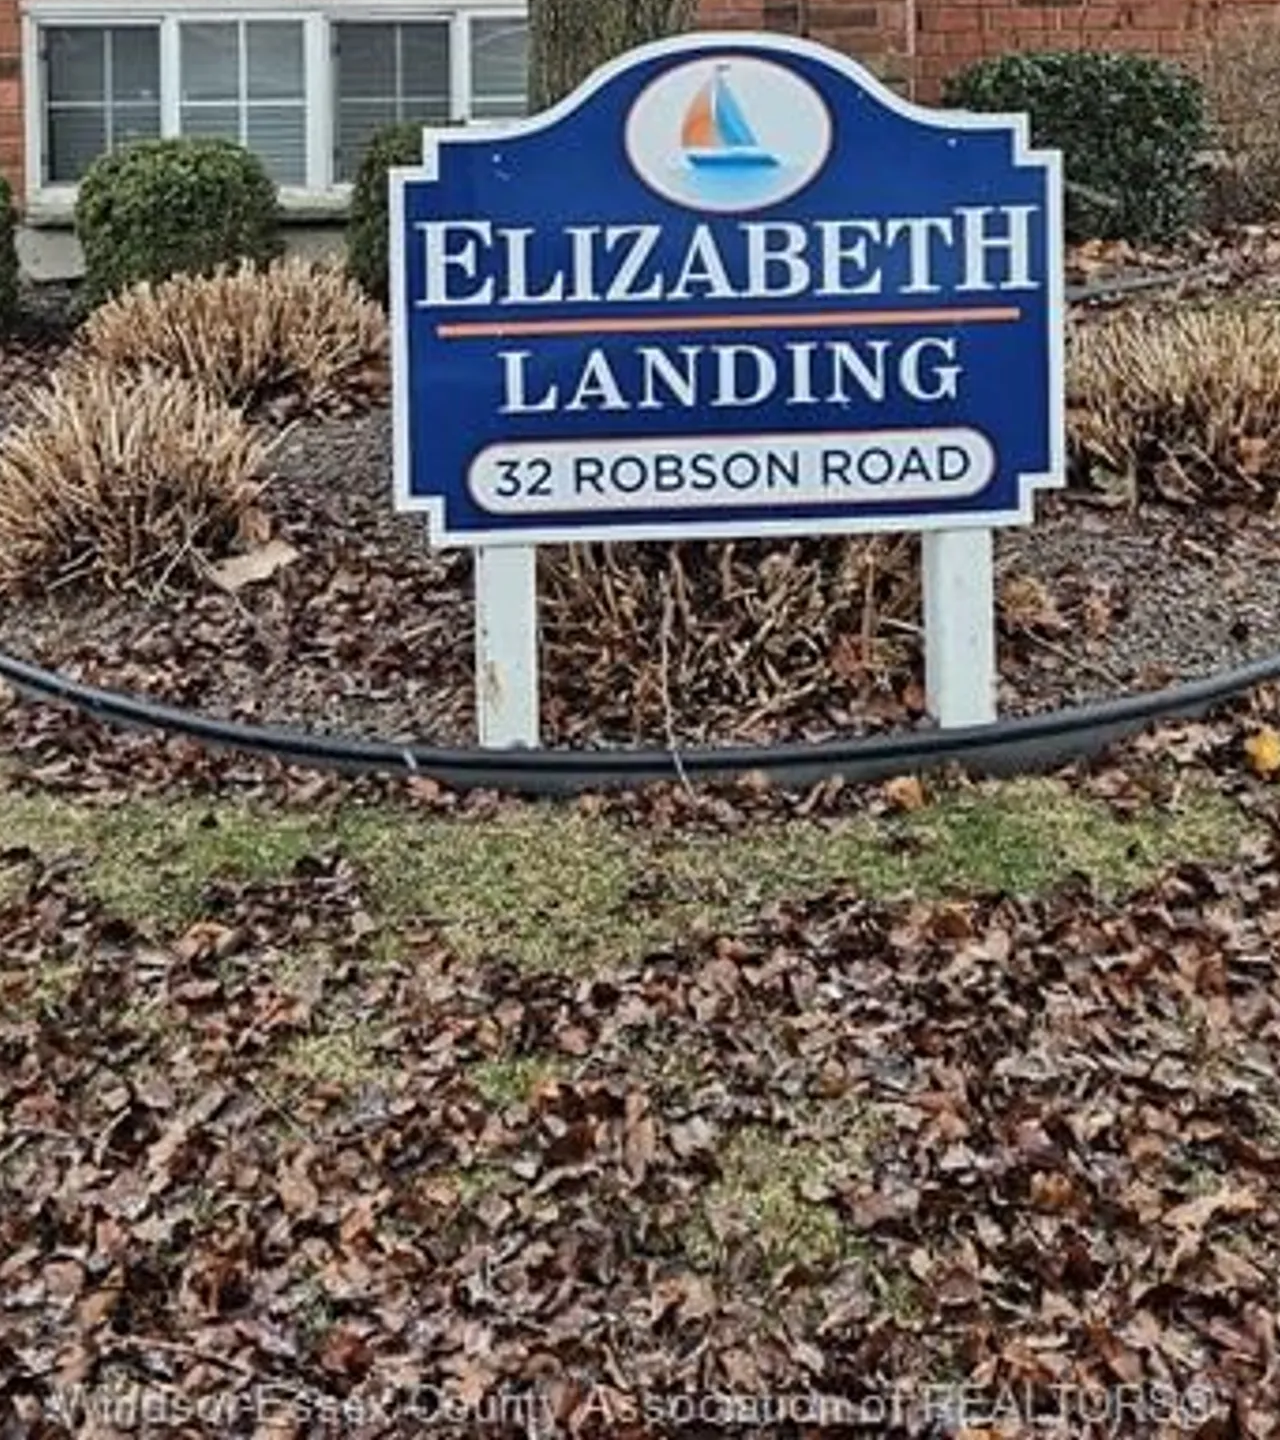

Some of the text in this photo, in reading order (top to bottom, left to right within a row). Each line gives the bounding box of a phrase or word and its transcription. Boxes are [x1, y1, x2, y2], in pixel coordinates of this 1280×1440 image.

[415, 205, 1039, 309] ELIZABETH
[498, 337, 963, 414] LANDING
[495, 443, 971, 497] 32 ROBSON ROAD
